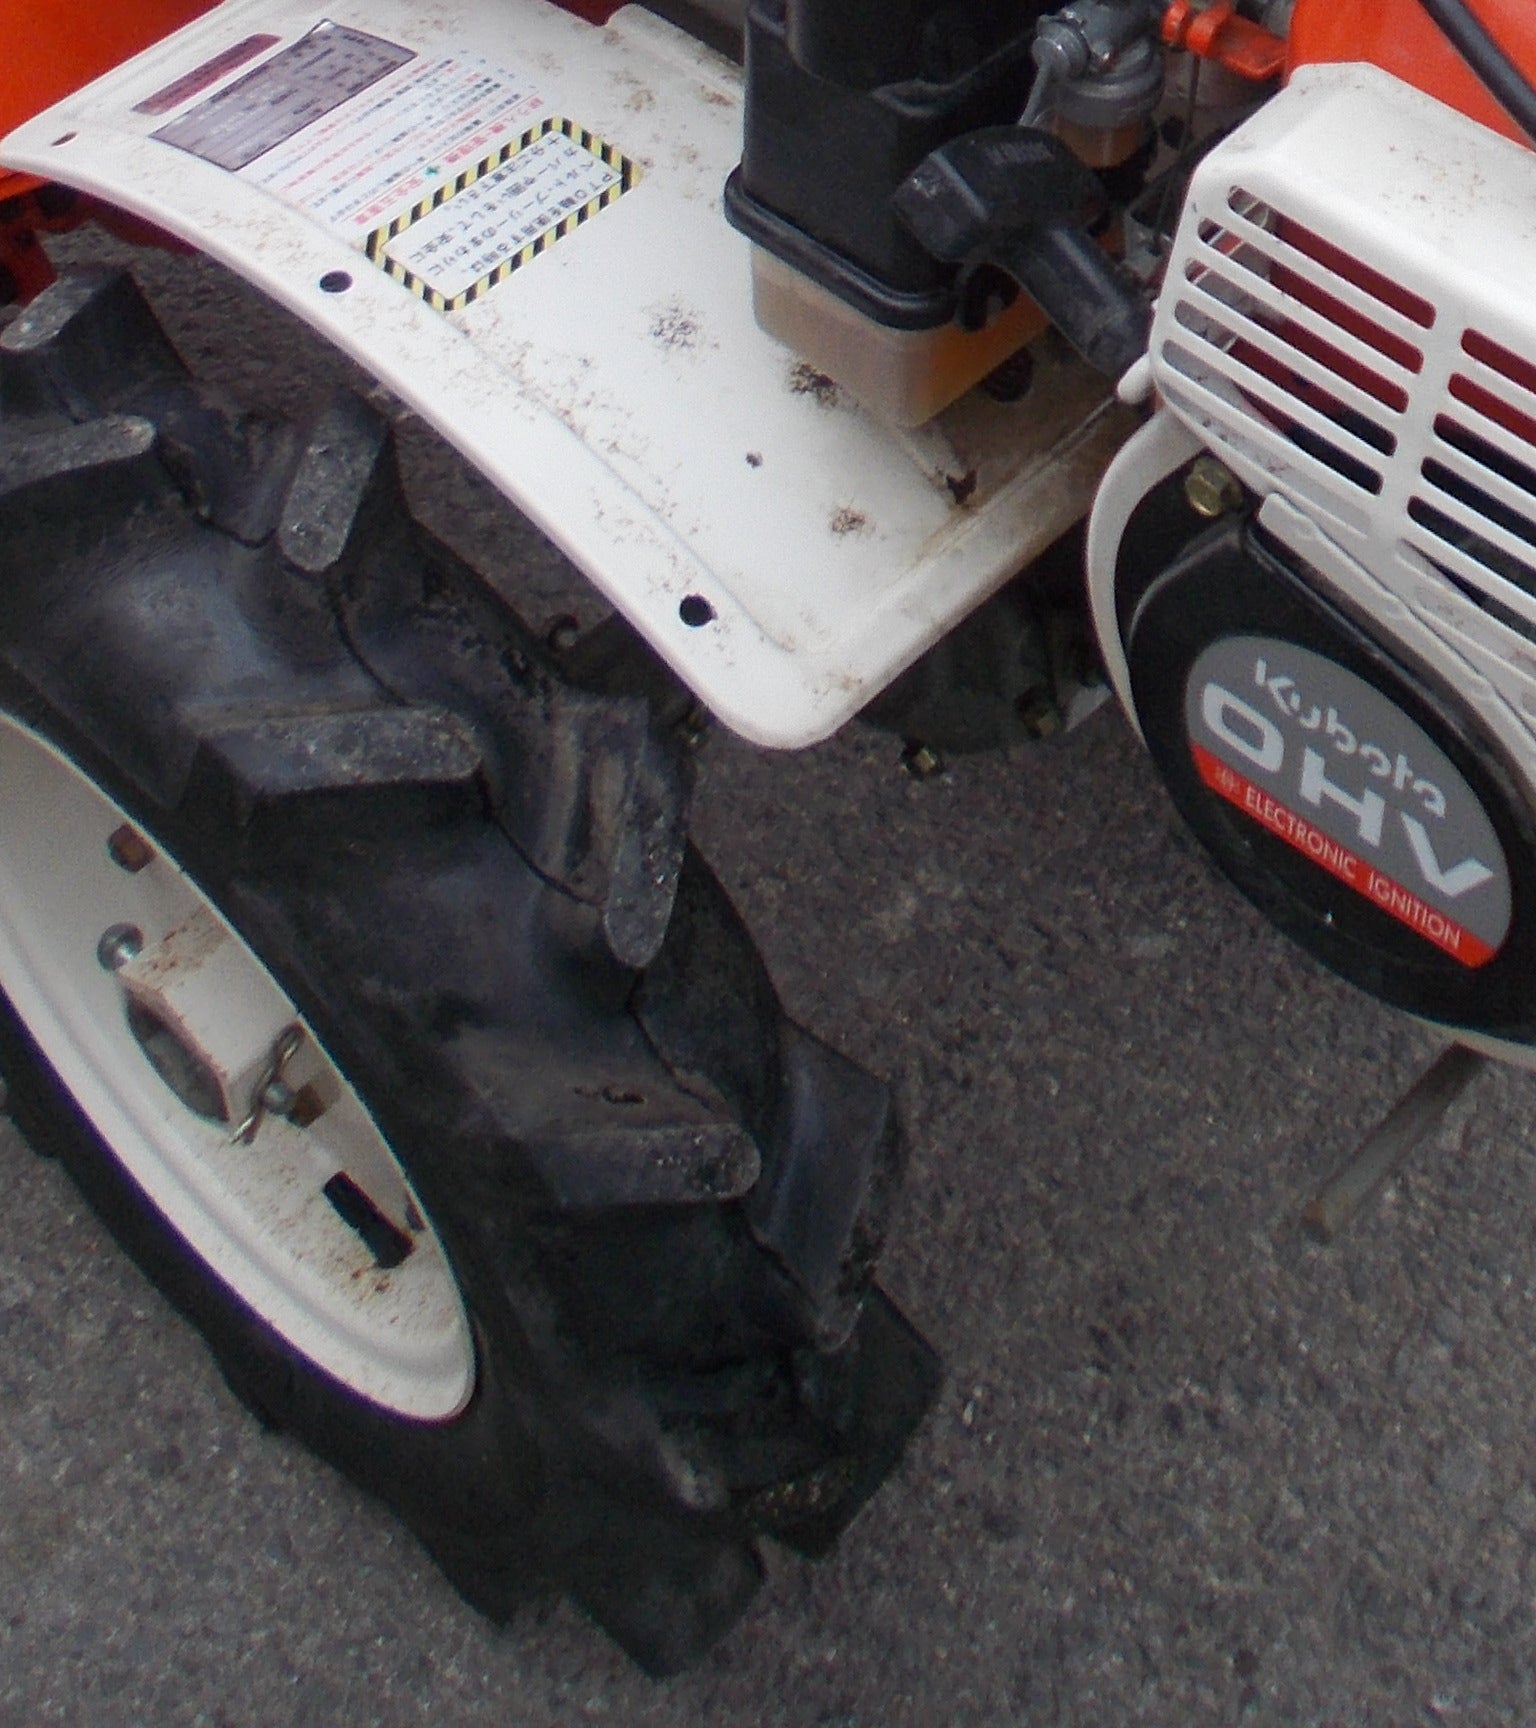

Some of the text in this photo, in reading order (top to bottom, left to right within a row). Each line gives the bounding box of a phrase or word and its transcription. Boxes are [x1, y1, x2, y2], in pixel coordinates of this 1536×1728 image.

[1201, 681, 1493, 898] OHV
[1254, 658, 1448, 818] Kubota
[1245, 780, 1463, 949] ELECTRONIC IGNITION
